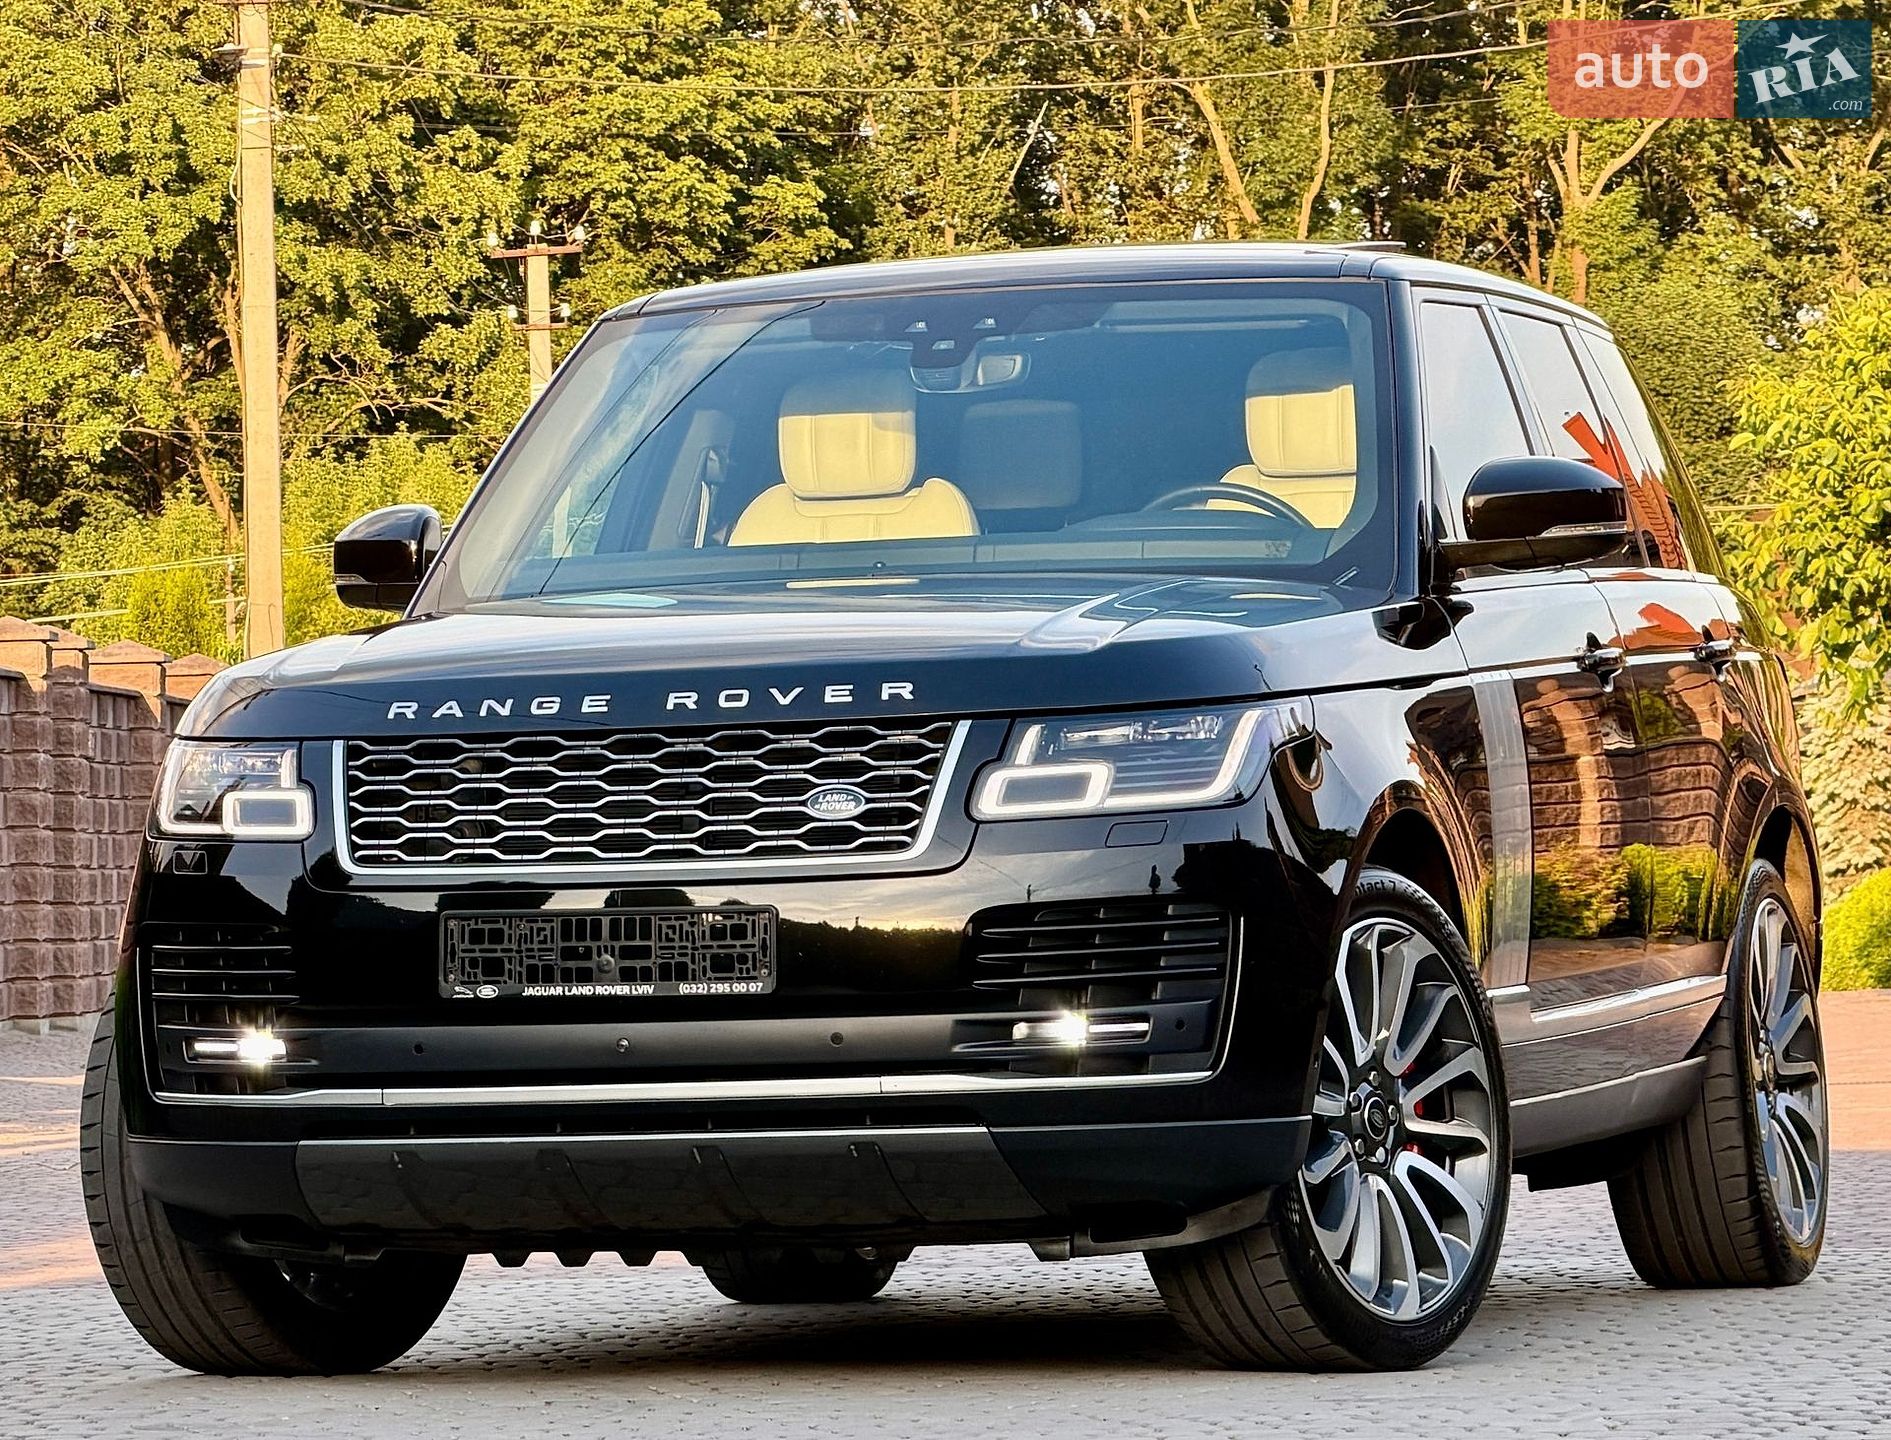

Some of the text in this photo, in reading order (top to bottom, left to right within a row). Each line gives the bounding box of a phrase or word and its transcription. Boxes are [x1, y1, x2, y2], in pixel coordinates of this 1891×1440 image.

[386, 681, 915, 720] RANGE ROVER
[818, 792, 848, 802] LAND
[819, 801, 857, 811] ROVER
[521, 984, 655, 996] JAGUAR LAND ROVER LVIV
[678, 982, 764, 995] (032) 295 00 07
